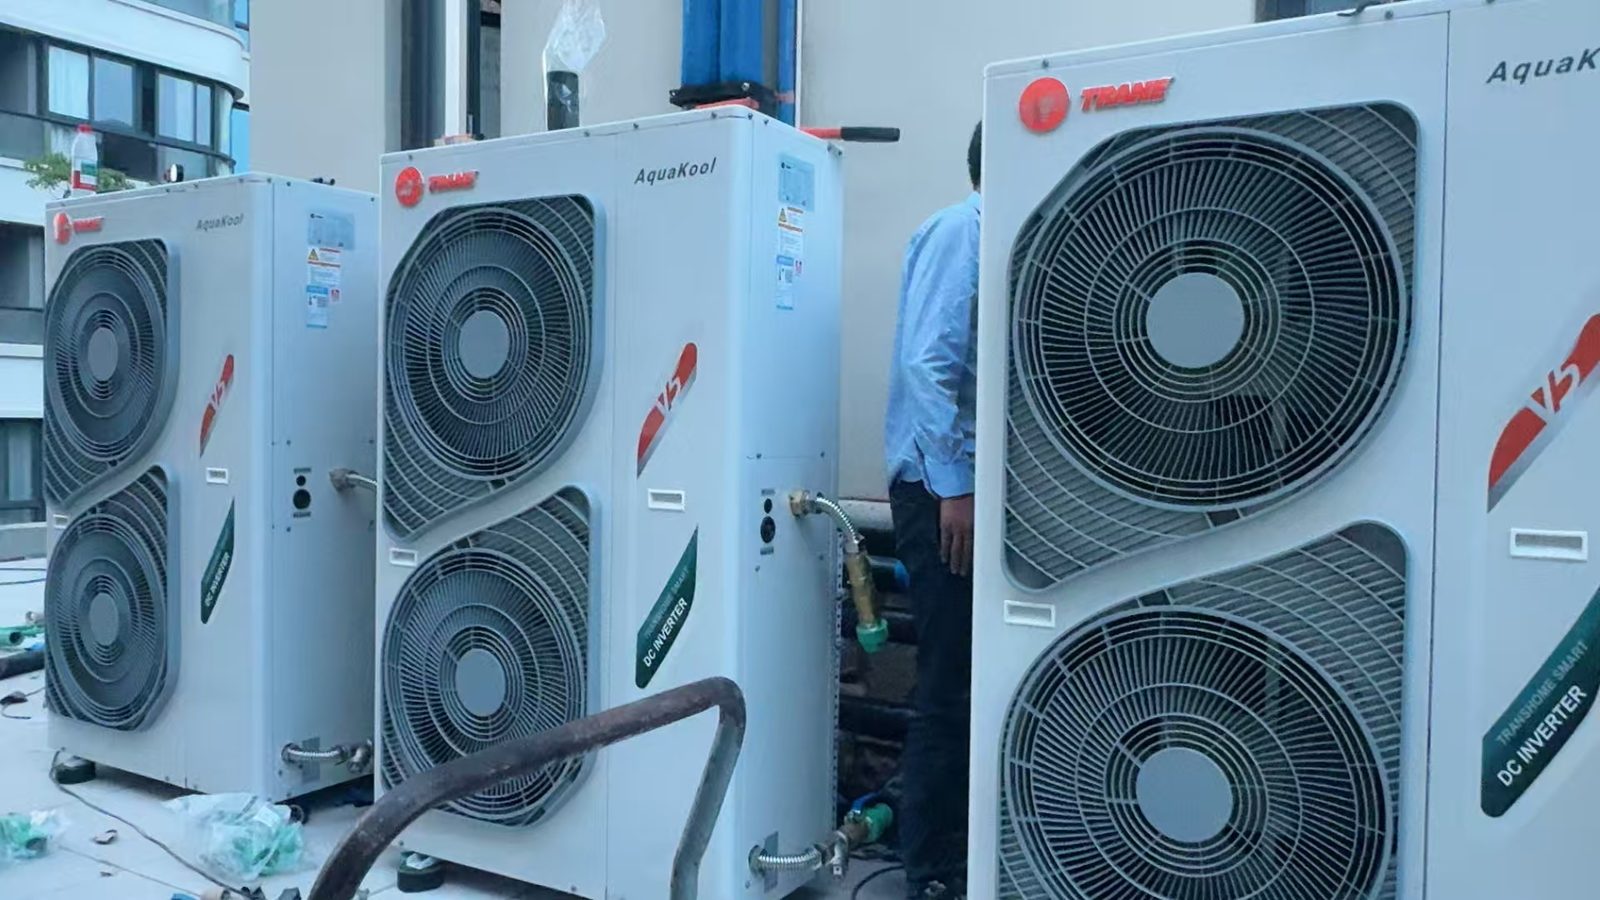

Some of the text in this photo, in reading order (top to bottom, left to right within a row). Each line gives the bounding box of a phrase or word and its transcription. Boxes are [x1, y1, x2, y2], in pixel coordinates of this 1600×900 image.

[1081, 77, 1175, 112] TRANE
[634, 157, 717, 186] AquaKool
[643, 597, 688, 667] DC INVERTER
[1495, 639, 1589, 746] TRANSHOME SMART
[1497, 684, 1588, 786] DC INVERTER
